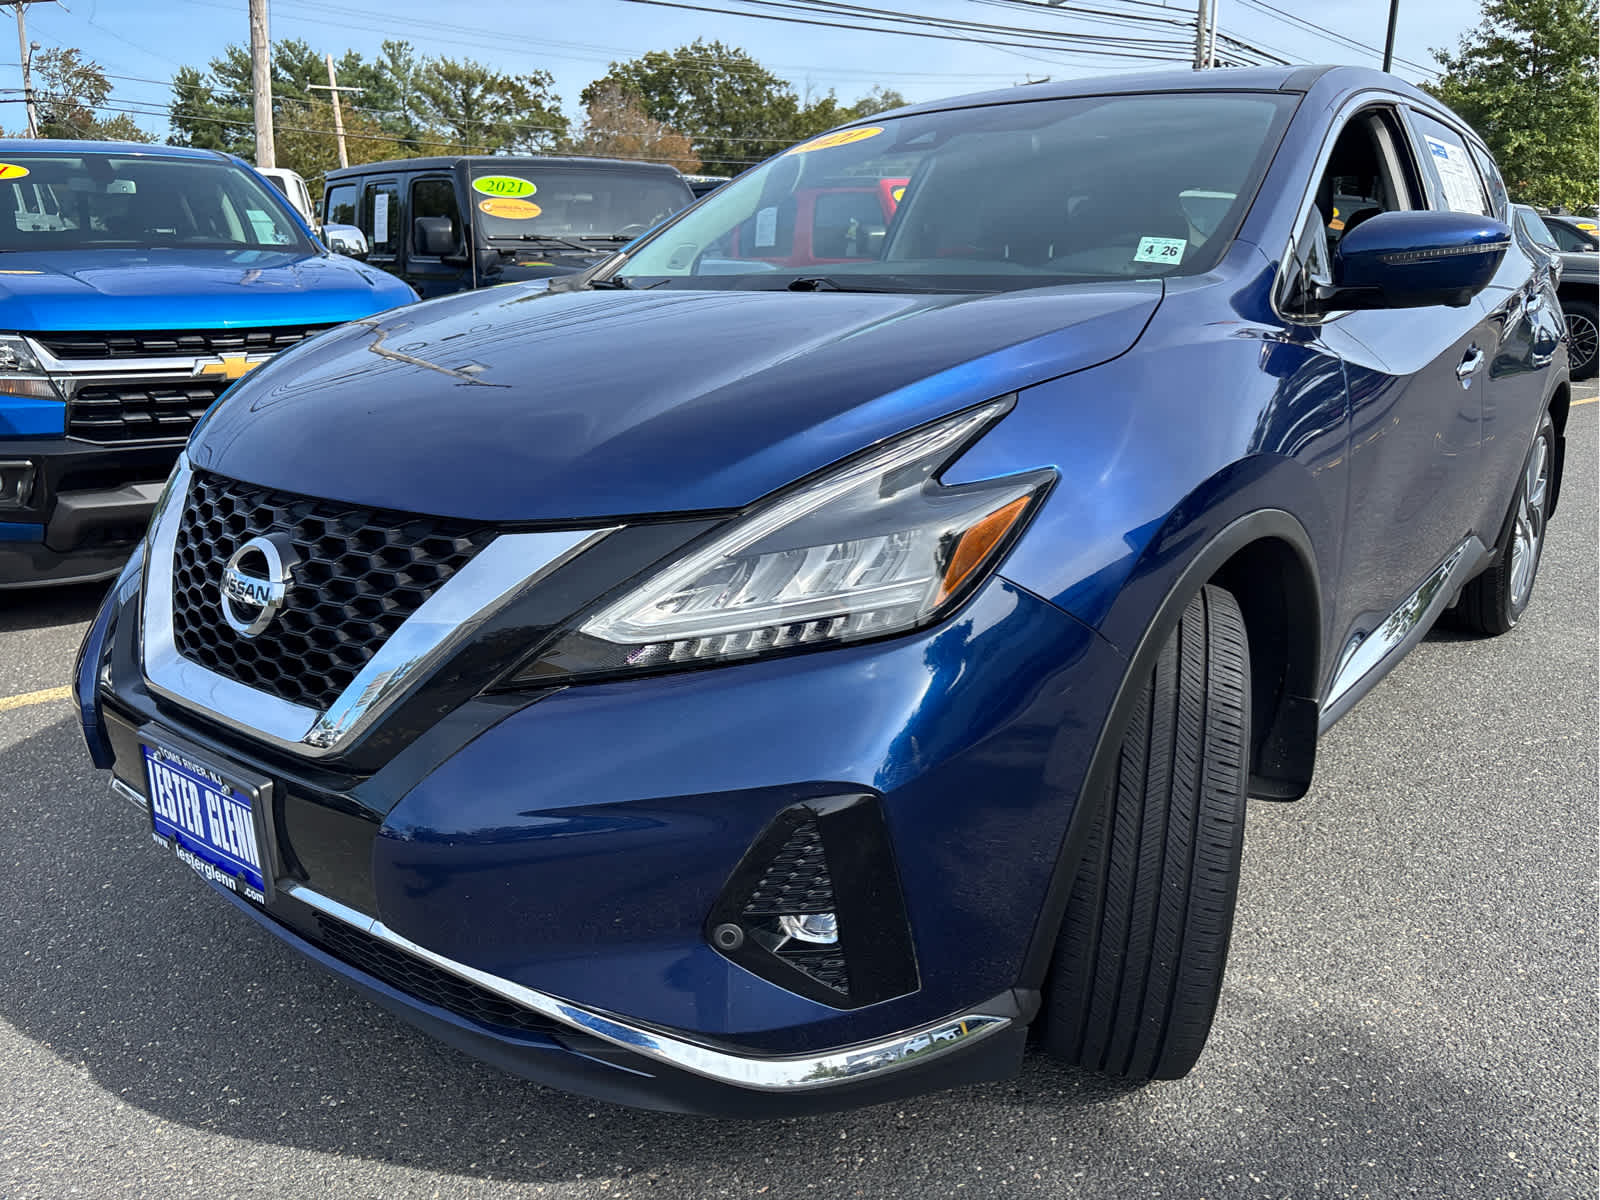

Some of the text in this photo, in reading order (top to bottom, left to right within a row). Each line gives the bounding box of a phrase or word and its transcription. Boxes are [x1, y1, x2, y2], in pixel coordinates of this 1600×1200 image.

[486, 180, 524, 193] 2021
[1145, 245, 1178, 256] 4 26
[158, 746, 182, 766] TOMS
[209, 771, 223, 786] NJ
[147, 760, 261, 869] LESTER GLENN
[175, 844, 237, 891] lesterglenn
[244, 887, 265, 905] .com
